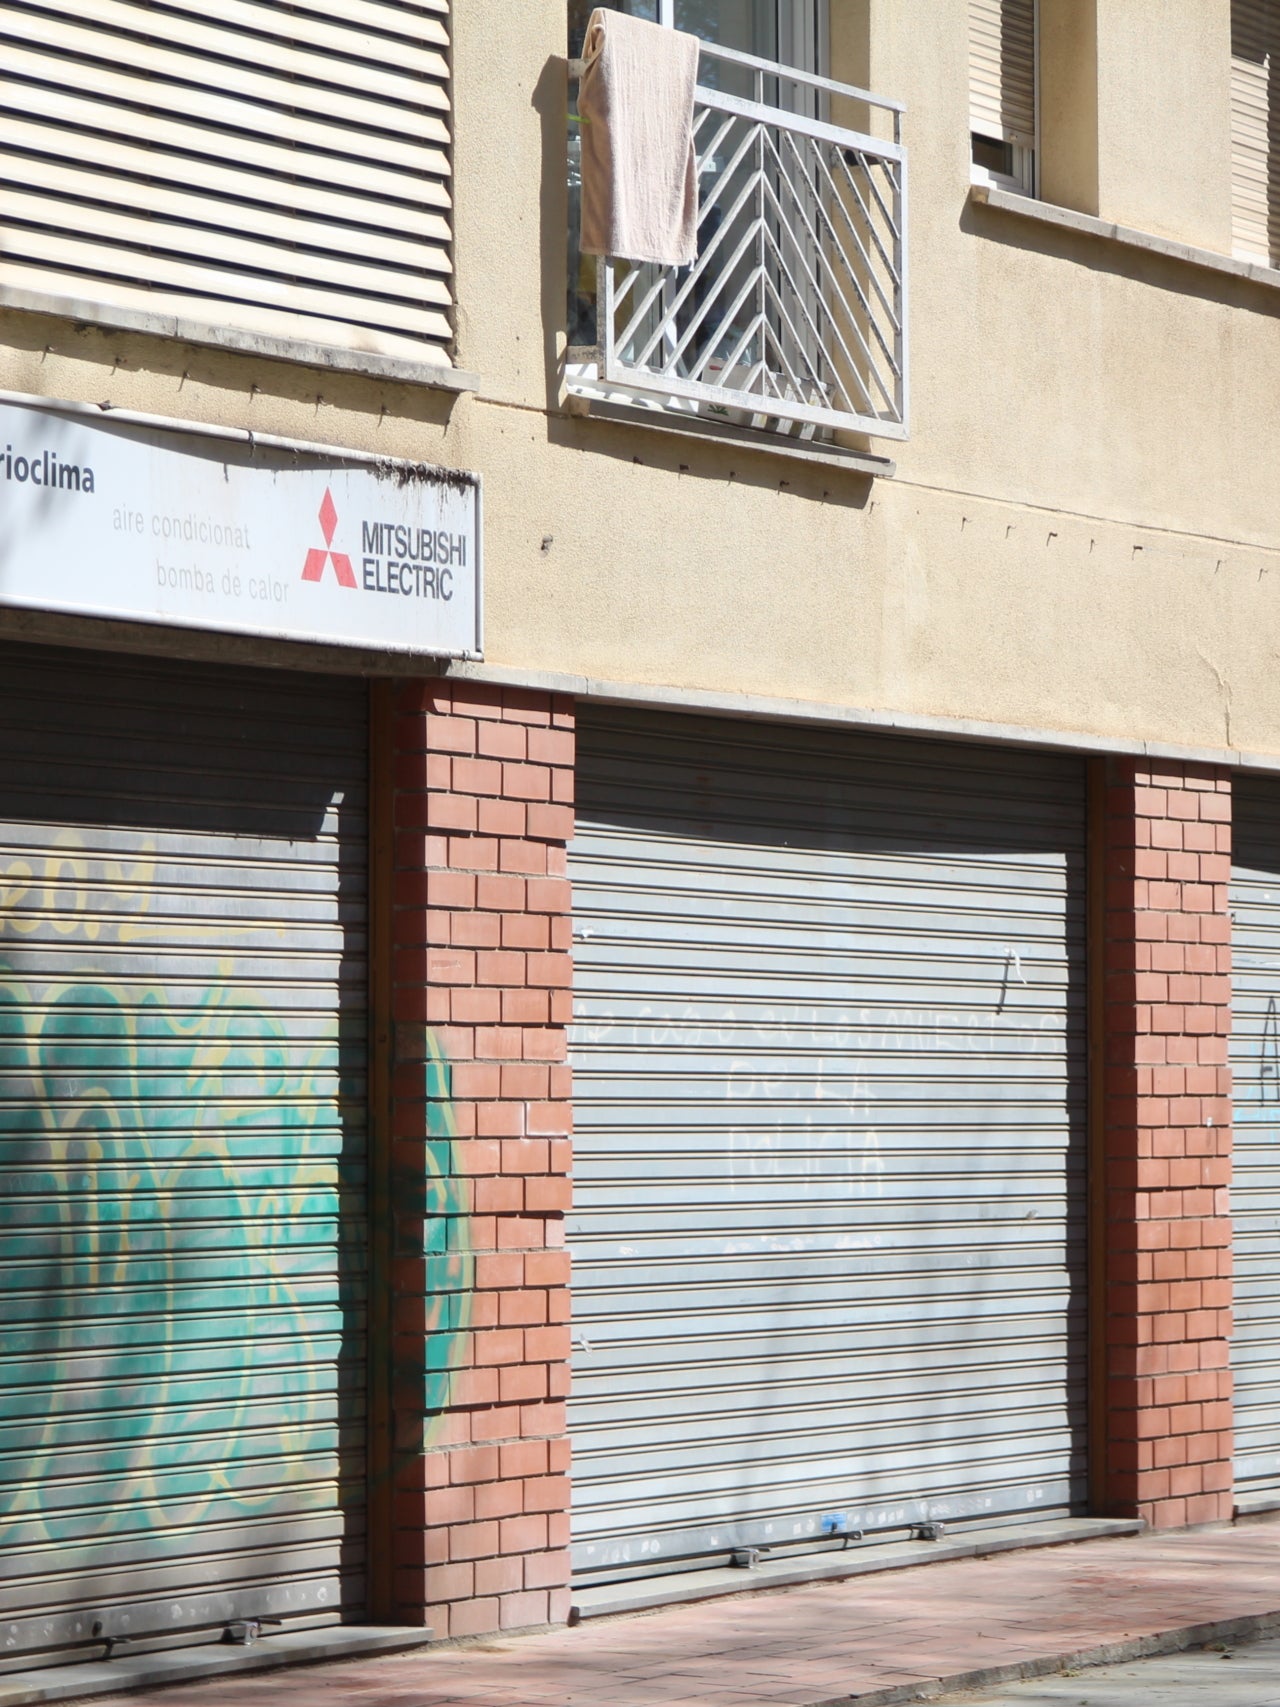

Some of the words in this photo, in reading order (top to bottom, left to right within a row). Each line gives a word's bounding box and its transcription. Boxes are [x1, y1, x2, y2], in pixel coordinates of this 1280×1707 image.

[112, 503, 145, 534] aire
[151, 514, 250, 550] condicionat
[362, 520, 467, 567] MITSUBISHI
[156, 560, 216, 592] bomba
[221, 574, 243, 597] de
[248, 576, 289, 603] calor
[362, 558, 453, 602] ELECTRIC
